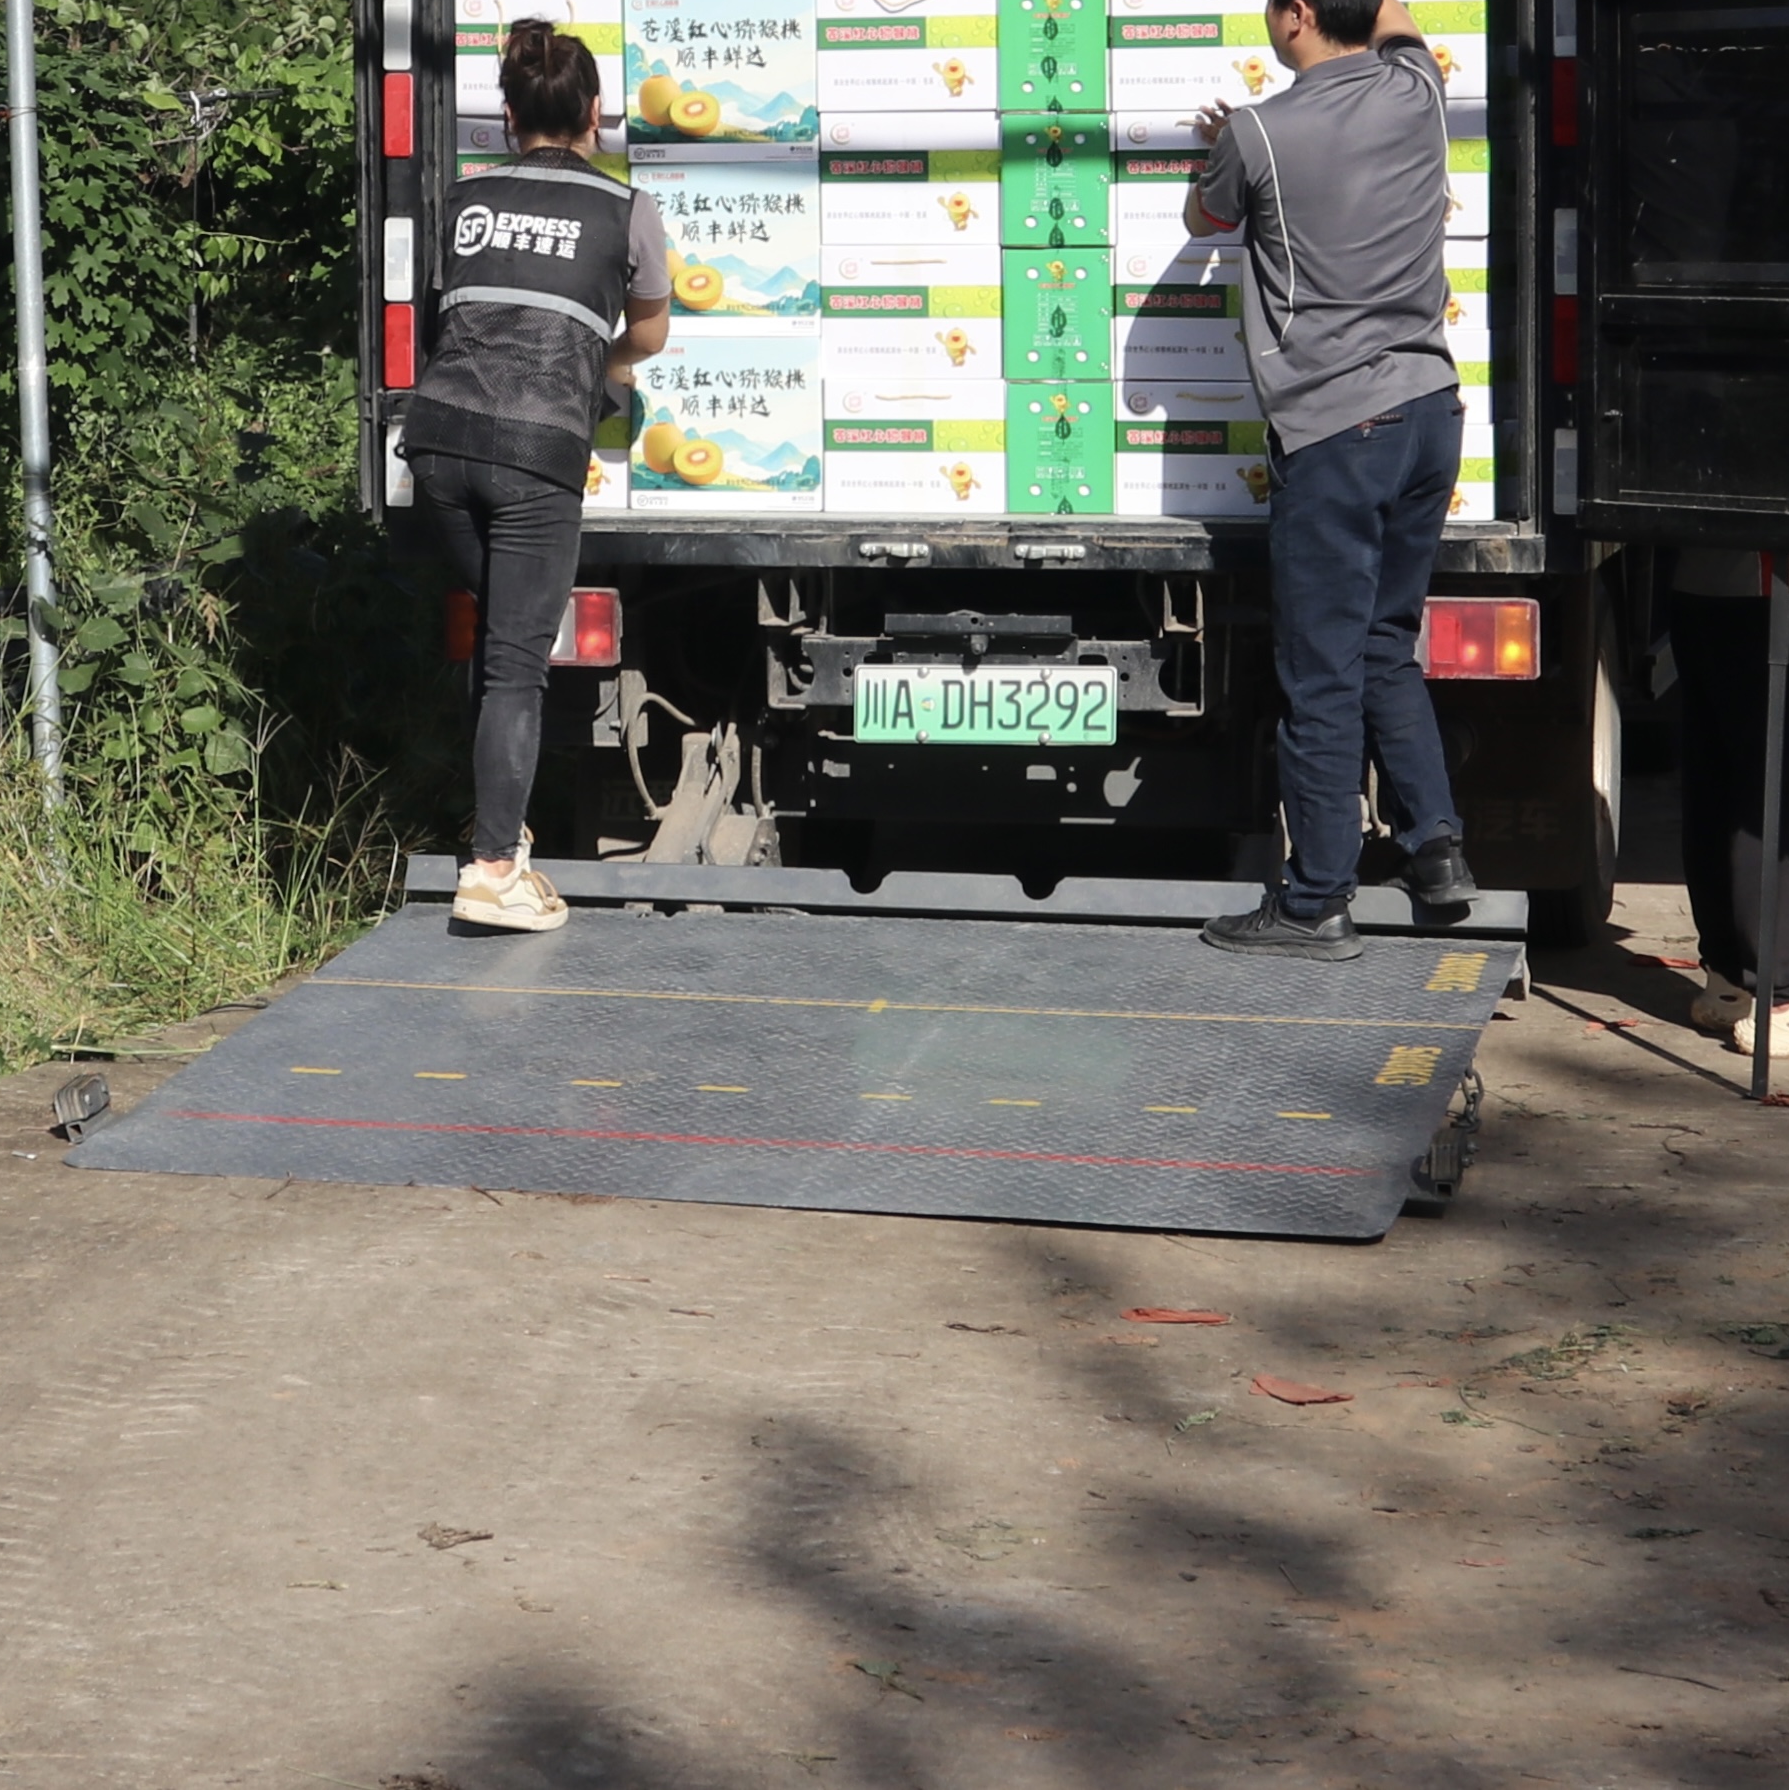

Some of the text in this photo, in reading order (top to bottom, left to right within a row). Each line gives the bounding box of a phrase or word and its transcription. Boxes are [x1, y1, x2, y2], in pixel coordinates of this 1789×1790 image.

[641, 17, 802, 43] 苍溪红心猕猴桃
[675, 45, 767, 69] 顺丰鲜达
[495, 212, 582, 239] EXPRESS
[680, 219, 770, 244] 顺丰鲜达
[490, 230, 576, 260] 顺丰速运
[646, 365, 806, 391] 苍溪红心猕猴桃
[680, 393, 770, 418] 顺丰鲜达
